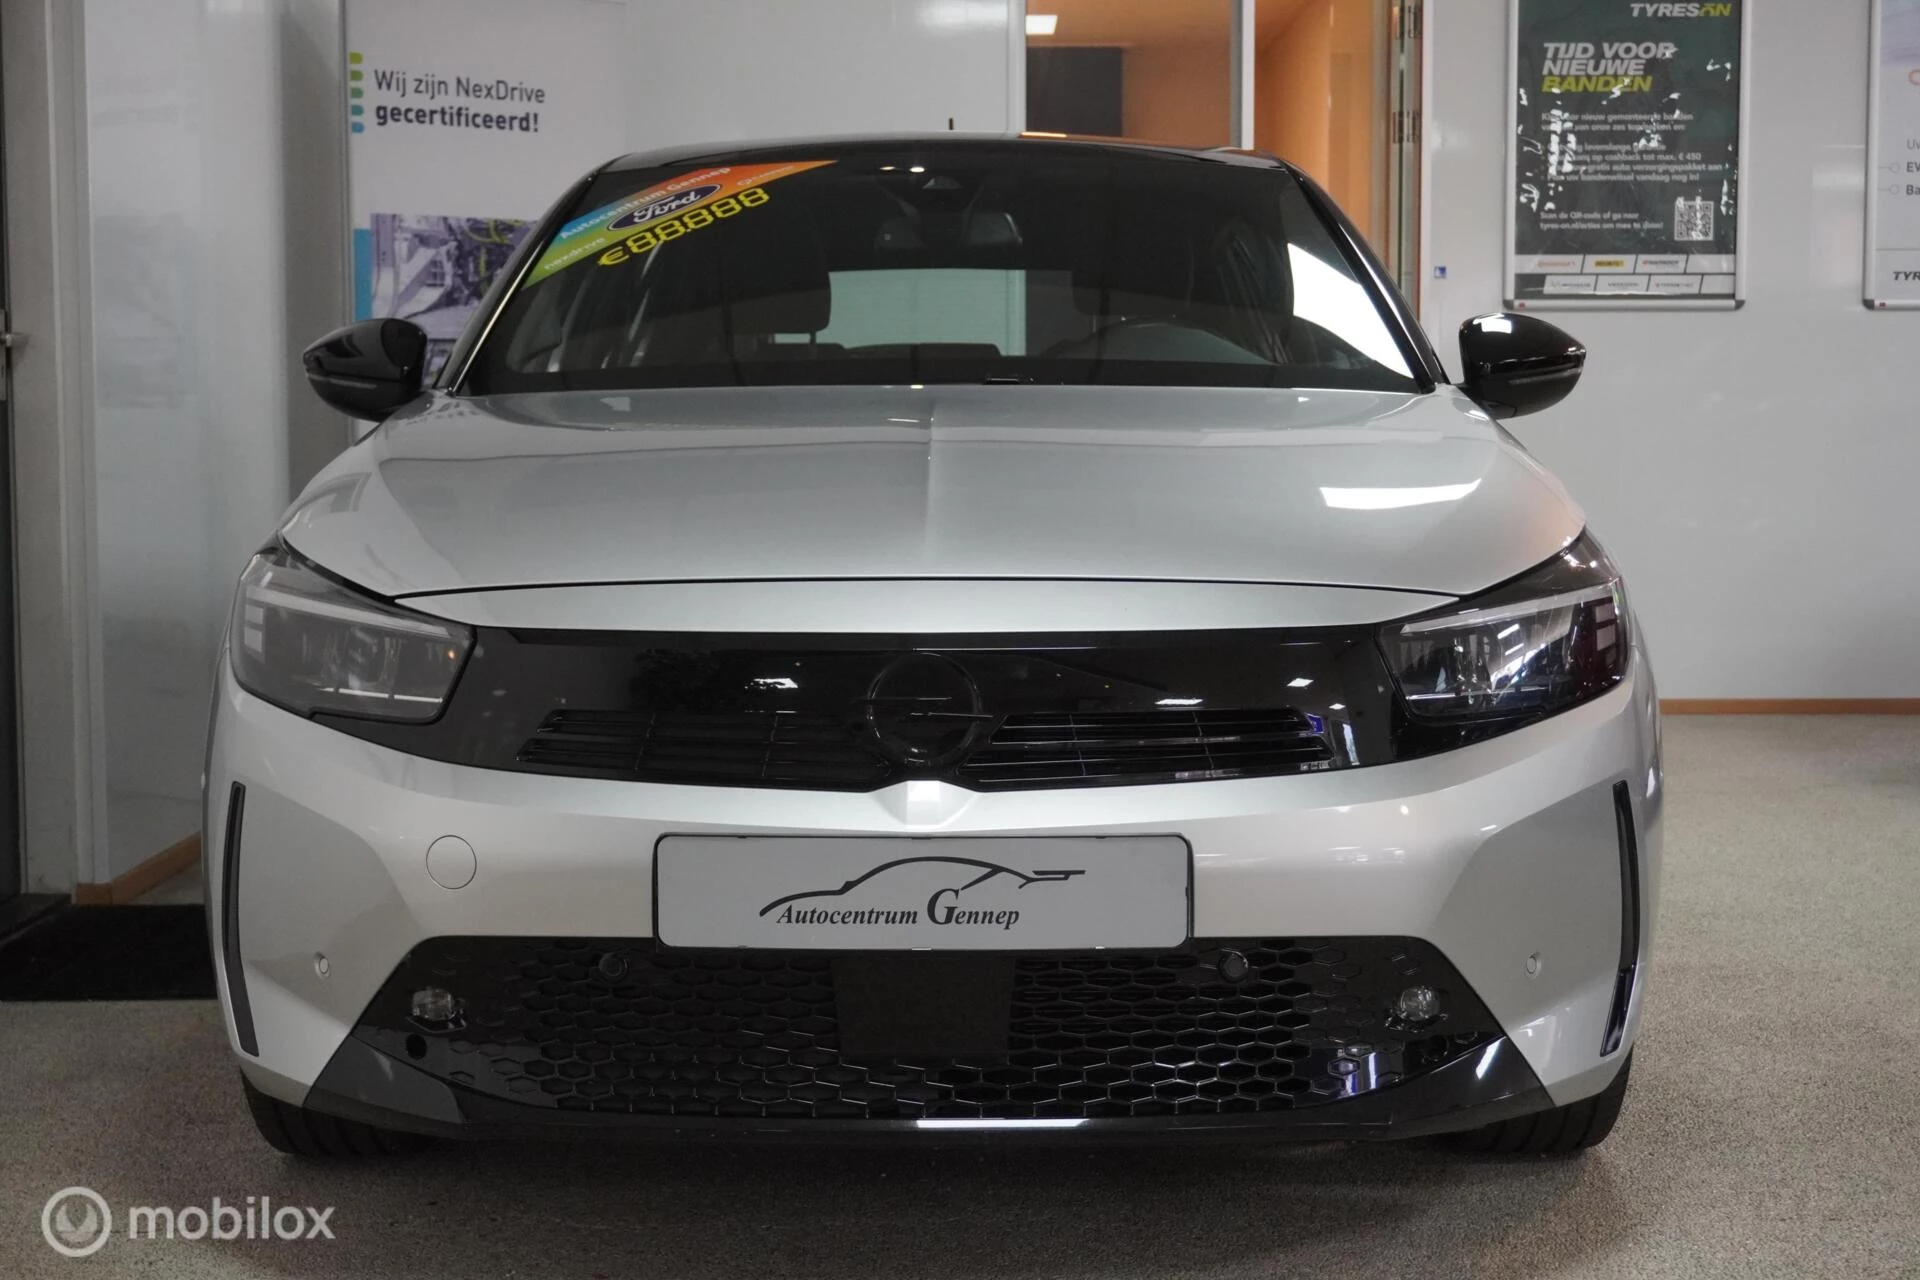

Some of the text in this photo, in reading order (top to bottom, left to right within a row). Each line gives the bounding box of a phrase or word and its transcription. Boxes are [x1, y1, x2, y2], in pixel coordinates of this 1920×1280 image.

[1602, 42, 1675, 59] VOOR
[1542, 59, 1646, 76] NIEUWE
[374, 69, 546, 104] Wij zijn NexDrive
[1541, 76, 1653, 93] BANDEN
[375, 105, 539, 133] gecertificeerd!
[633, 191, 701, 223] Ford
[776, 887, 1020, 930] Autocentrum Gennep
